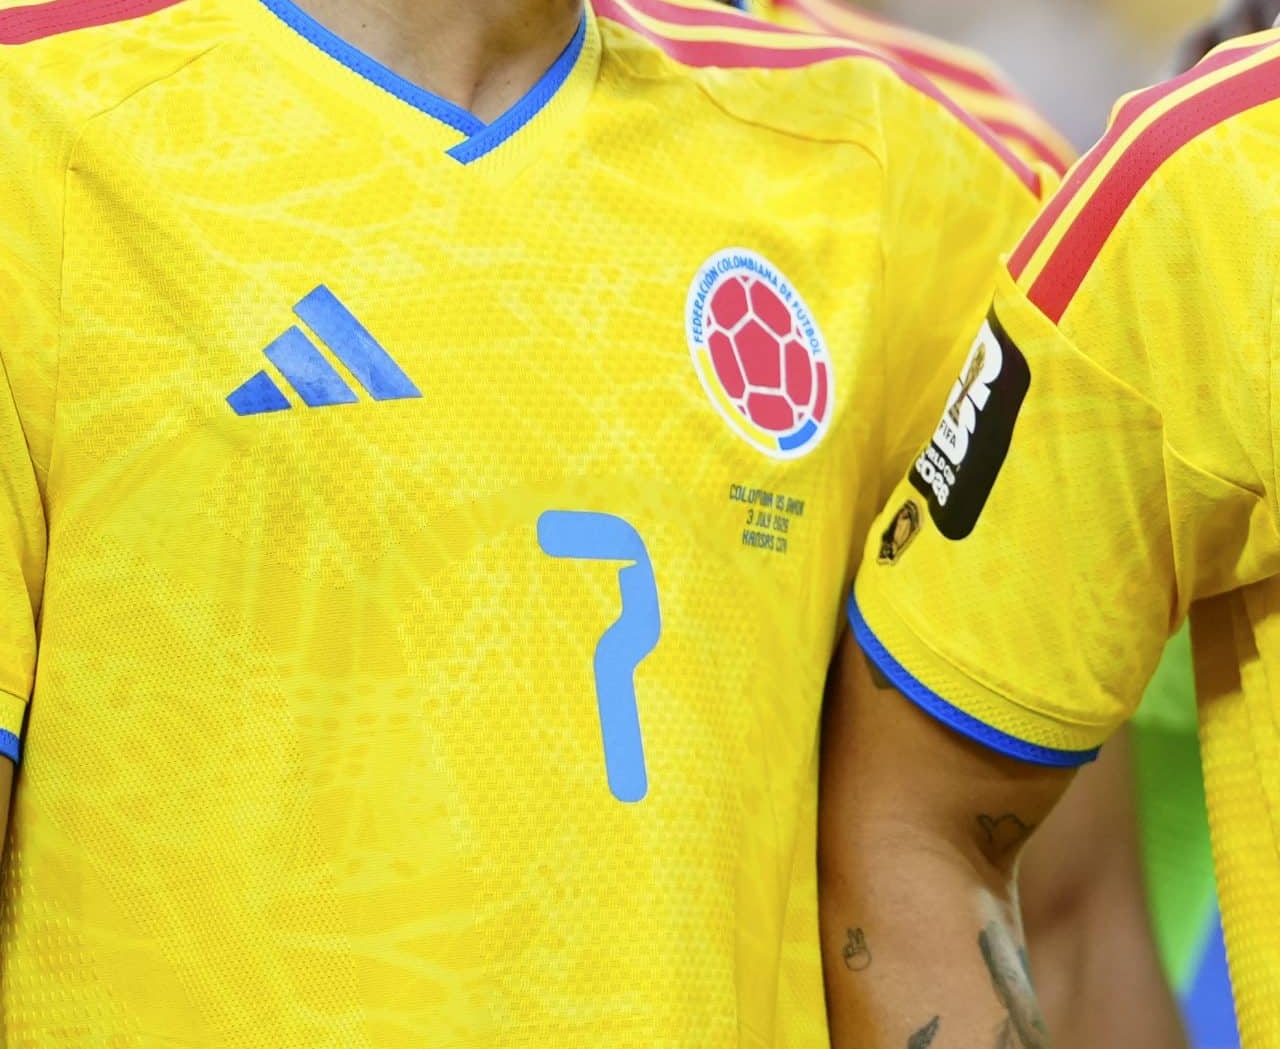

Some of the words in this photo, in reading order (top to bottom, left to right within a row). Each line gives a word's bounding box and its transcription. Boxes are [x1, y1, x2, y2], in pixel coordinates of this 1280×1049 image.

[717, 256, 777, 287] COLOMBIANA
[780, 283, 791, 302] DE
[939, 419, 957, 448] FIFA
[746, 508, 754, 525] 3
[536, 510, 661, 802] 7
